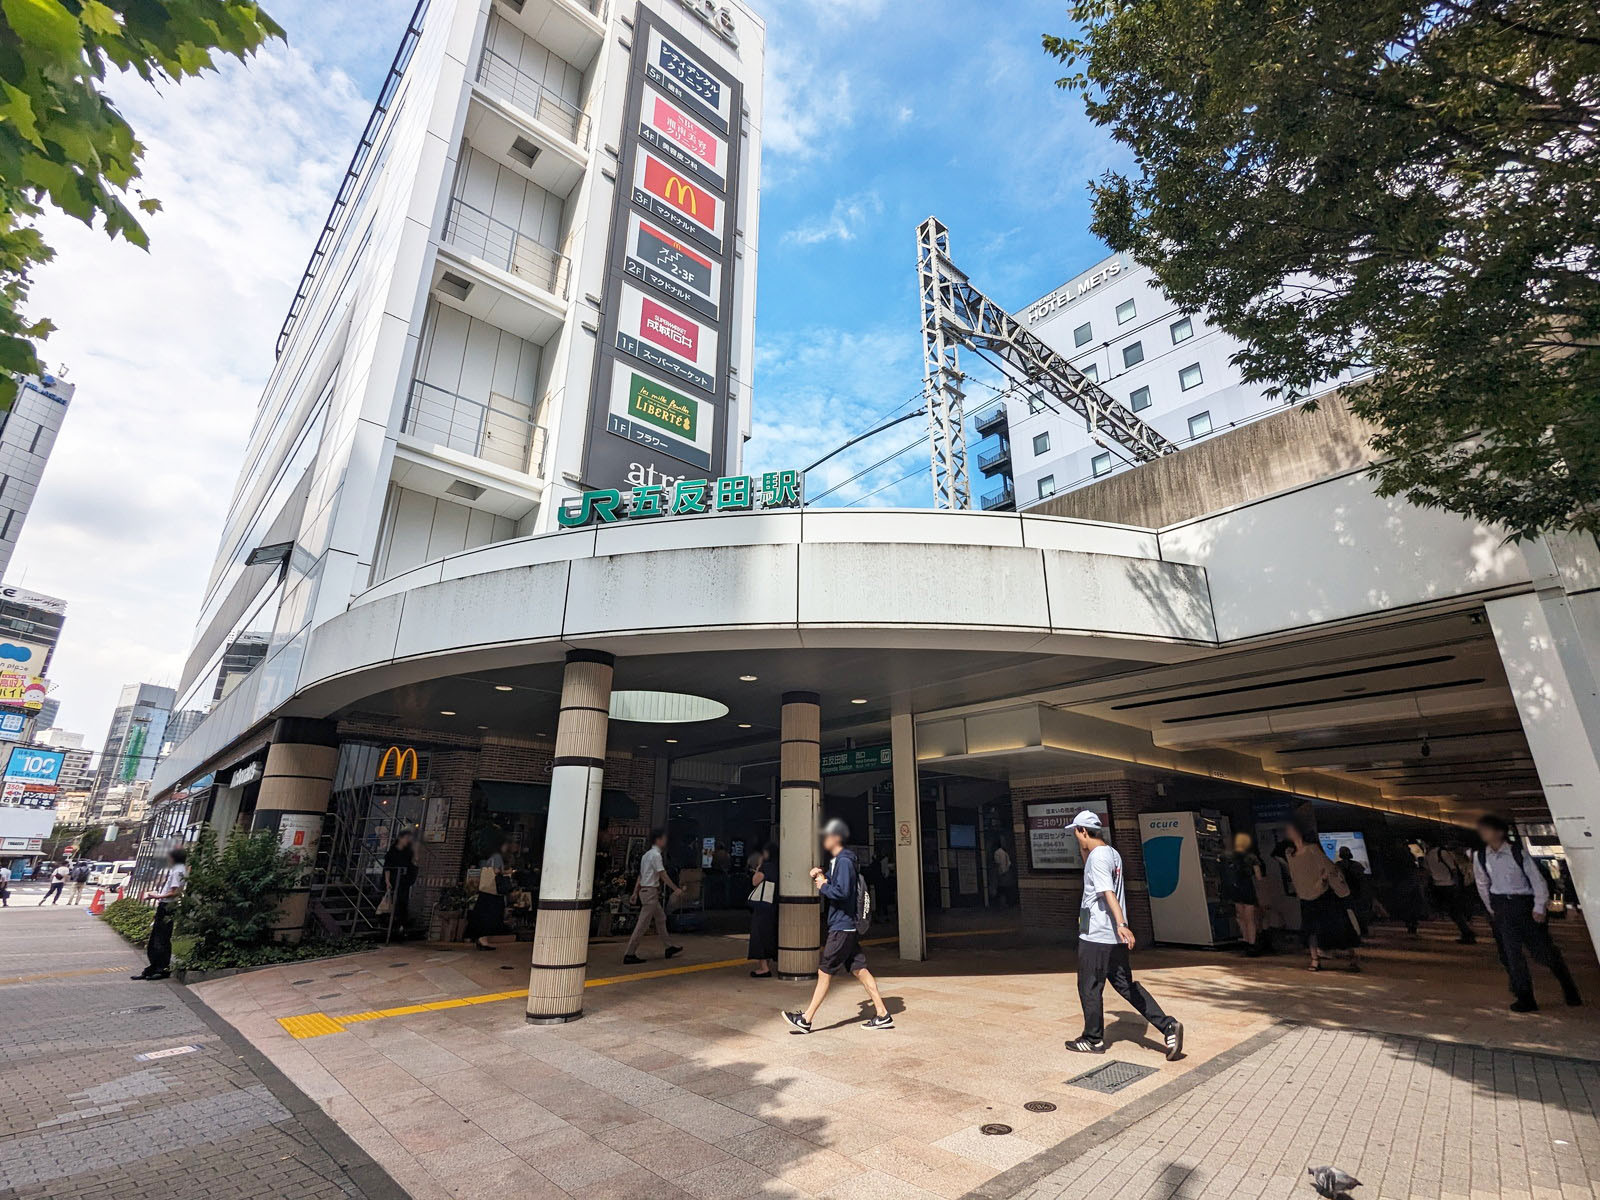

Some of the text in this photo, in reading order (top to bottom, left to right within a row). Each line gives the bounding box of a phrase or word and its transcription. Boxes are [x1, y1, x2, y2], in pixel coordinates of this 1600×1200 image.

[649, 68, 662, 80] 5F
[662, 46, 720, 93] シティデンタル
[667, 62, 712, 98] クリニック
[643, 129, 656, 140] 4F
[635, 193, 649, 209] 3F
[657, 206, 696, 233] マクドナルド
[628, 261, 642, 275] 2F
[650, 274, 692, 301] マクドナルド
[1028, 261, 1122, 325] HOTEL METS
[622, 337, 634, 351] 1F
[646, 318, 693, 349] 成城石井
[643, 349, 708, 385] スーパーマーケット
[614, 418, 626, 433] 1F
[636, 430, 669, 448] フラワー
[627, 462, 686, 488] atr
[1149, 819, 1179, 829] acure
